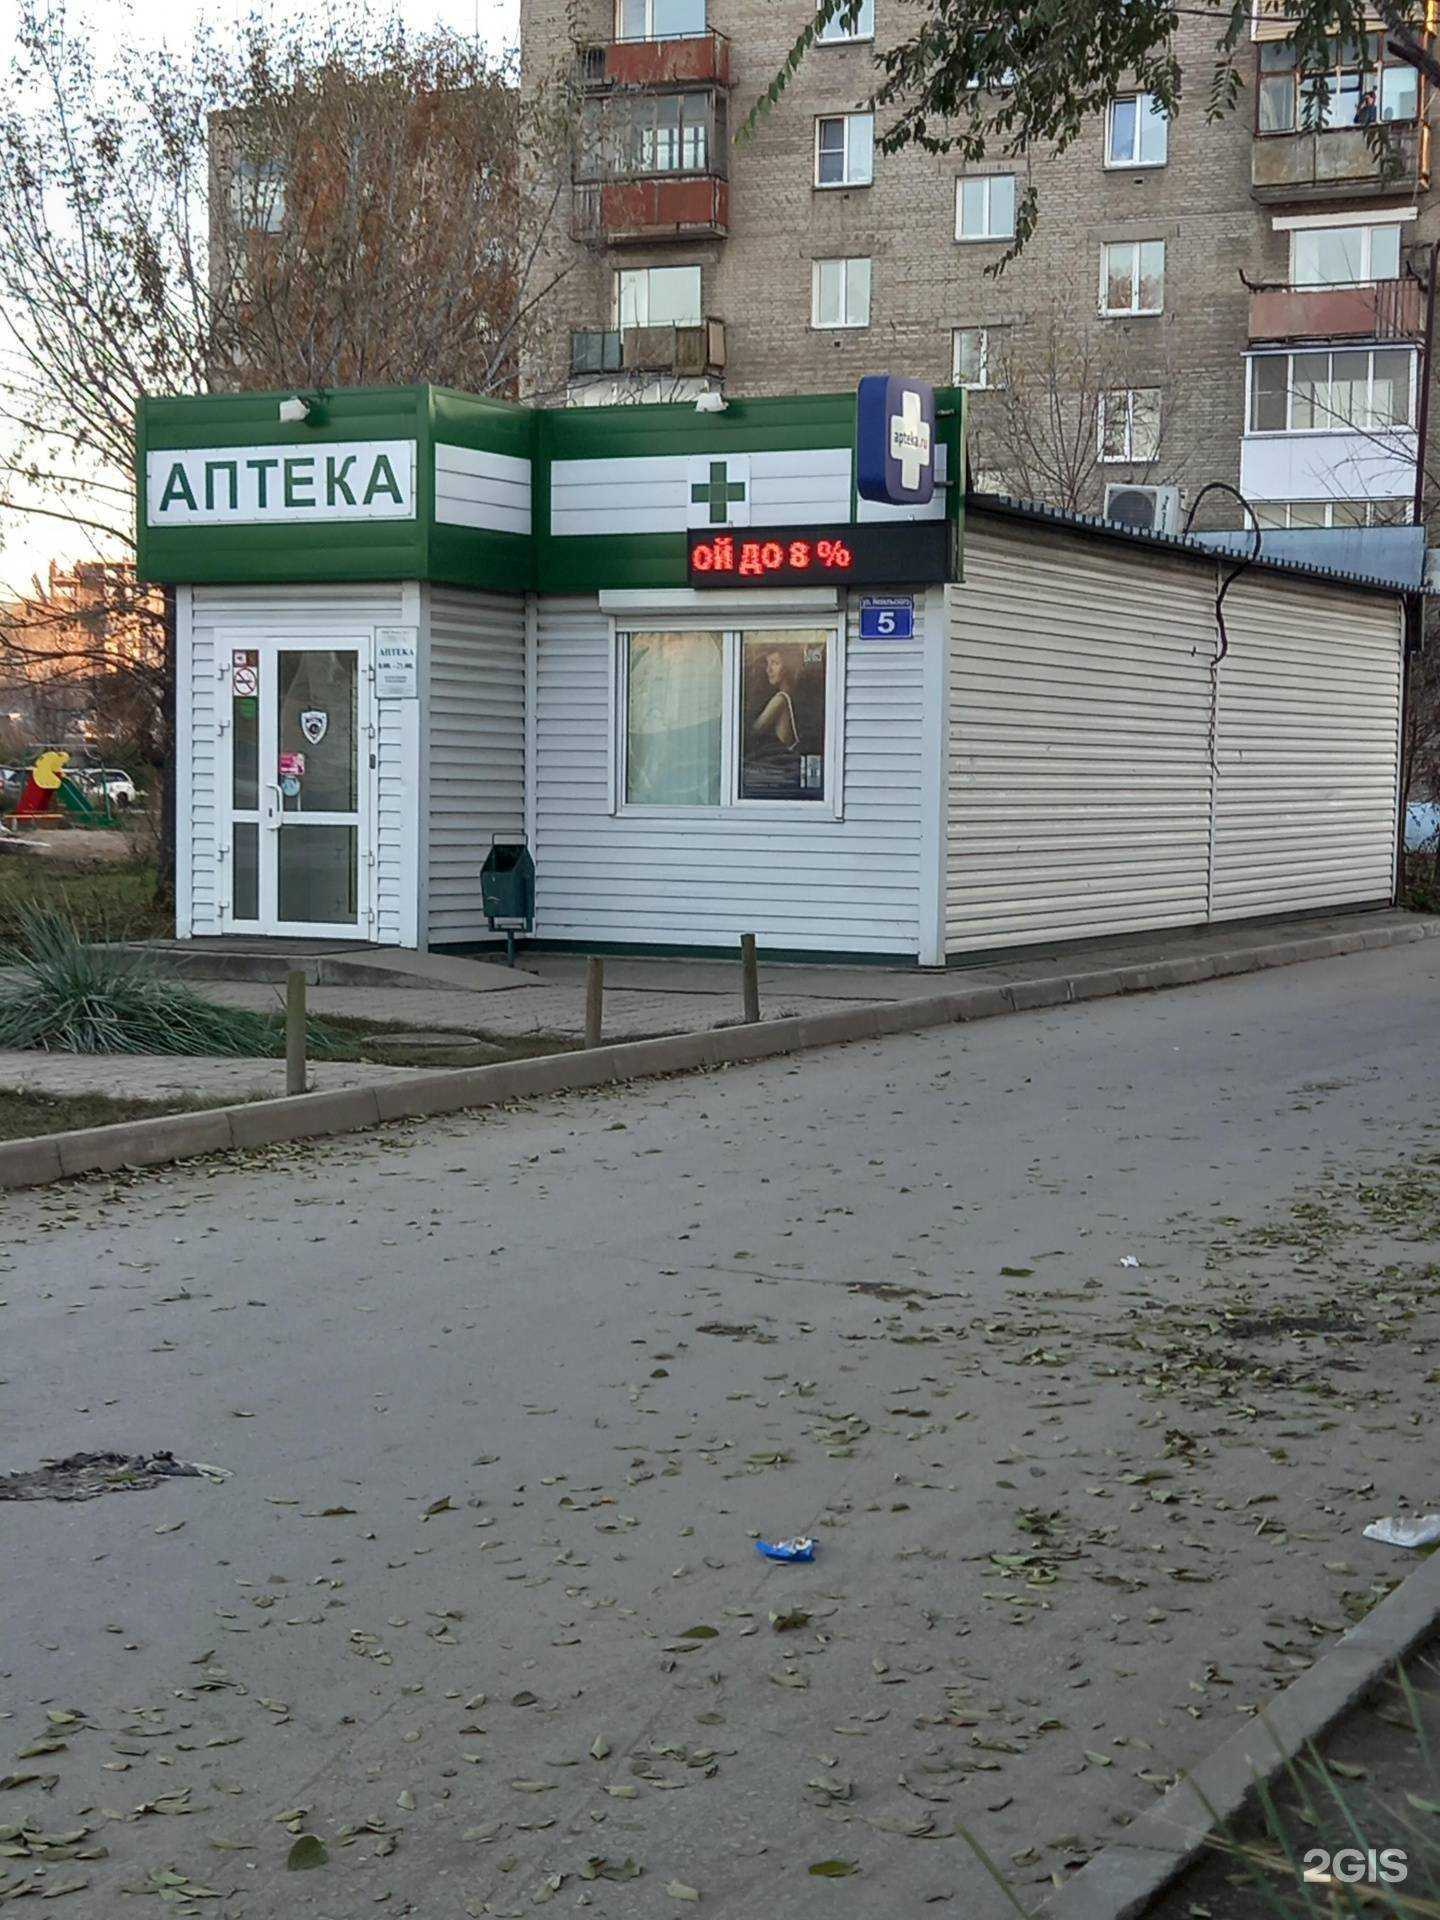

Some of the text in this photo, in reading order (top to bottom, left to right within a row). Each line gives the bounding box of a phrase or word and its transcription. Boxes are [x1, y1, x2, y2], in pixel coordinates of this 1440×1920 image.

[158, 454, 404, 512] АПТЕКА
[691, 535, 851, 576] ой до 8 %
[877, 611, 896, 634] 5
